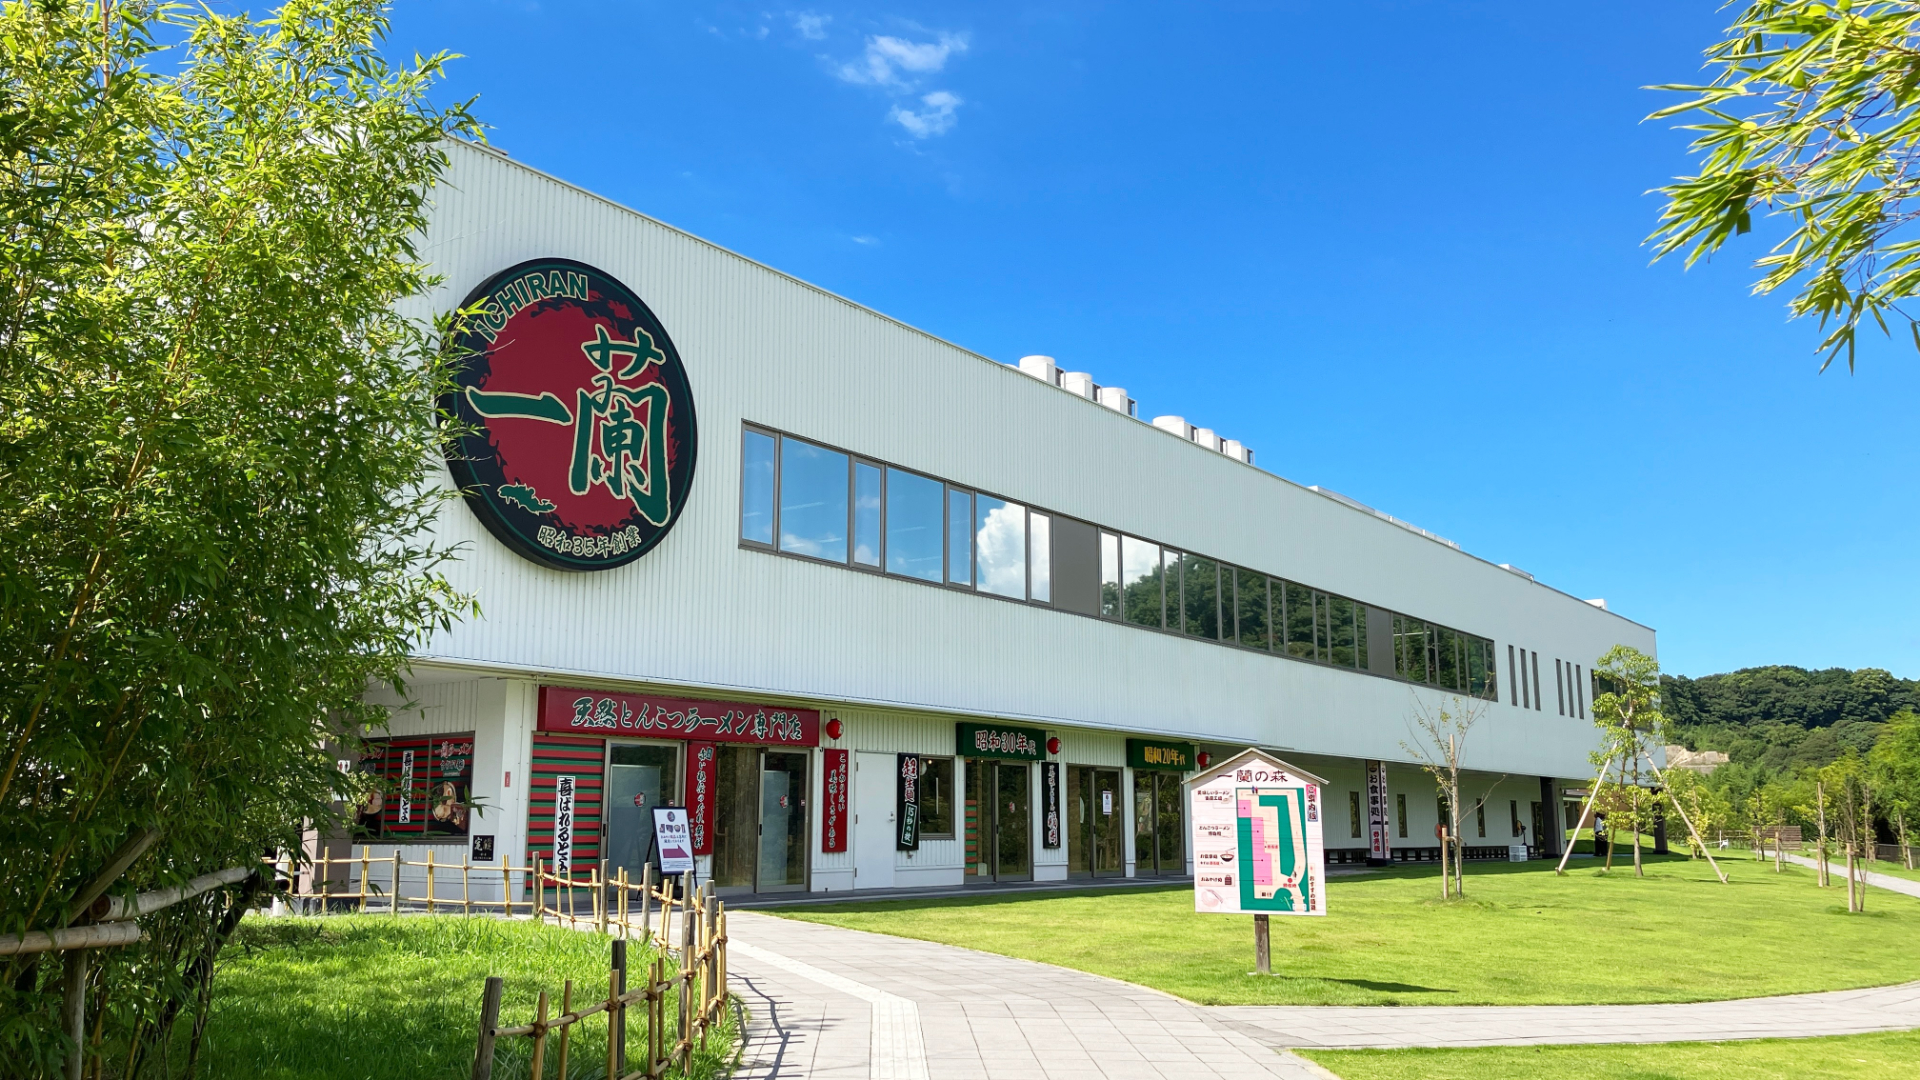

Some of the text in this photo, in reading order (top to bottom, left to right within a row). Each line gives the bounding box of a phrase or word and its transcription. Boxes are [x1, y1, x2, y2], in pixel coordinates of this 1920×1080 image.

[474, 270, 589, 345] ICHIRAN
[538, 525, 643, 559] 昭和35年創業
[571, 697, 803, 740] 天然とんこつラーメン専門店
[975, 730, 1037, 755] 昭和30年代
[1144, 746, 1186, 766] 昭和20年代
[838, 753, 847, 812] こだわりたい
[902, 757, 918, 802] 超生麺
[1217, 769, 1289, 784] 一蘭の森
[1369, 774, 1380, 816] お食事処
[828, 769, 838, 848] 美味しさがある
